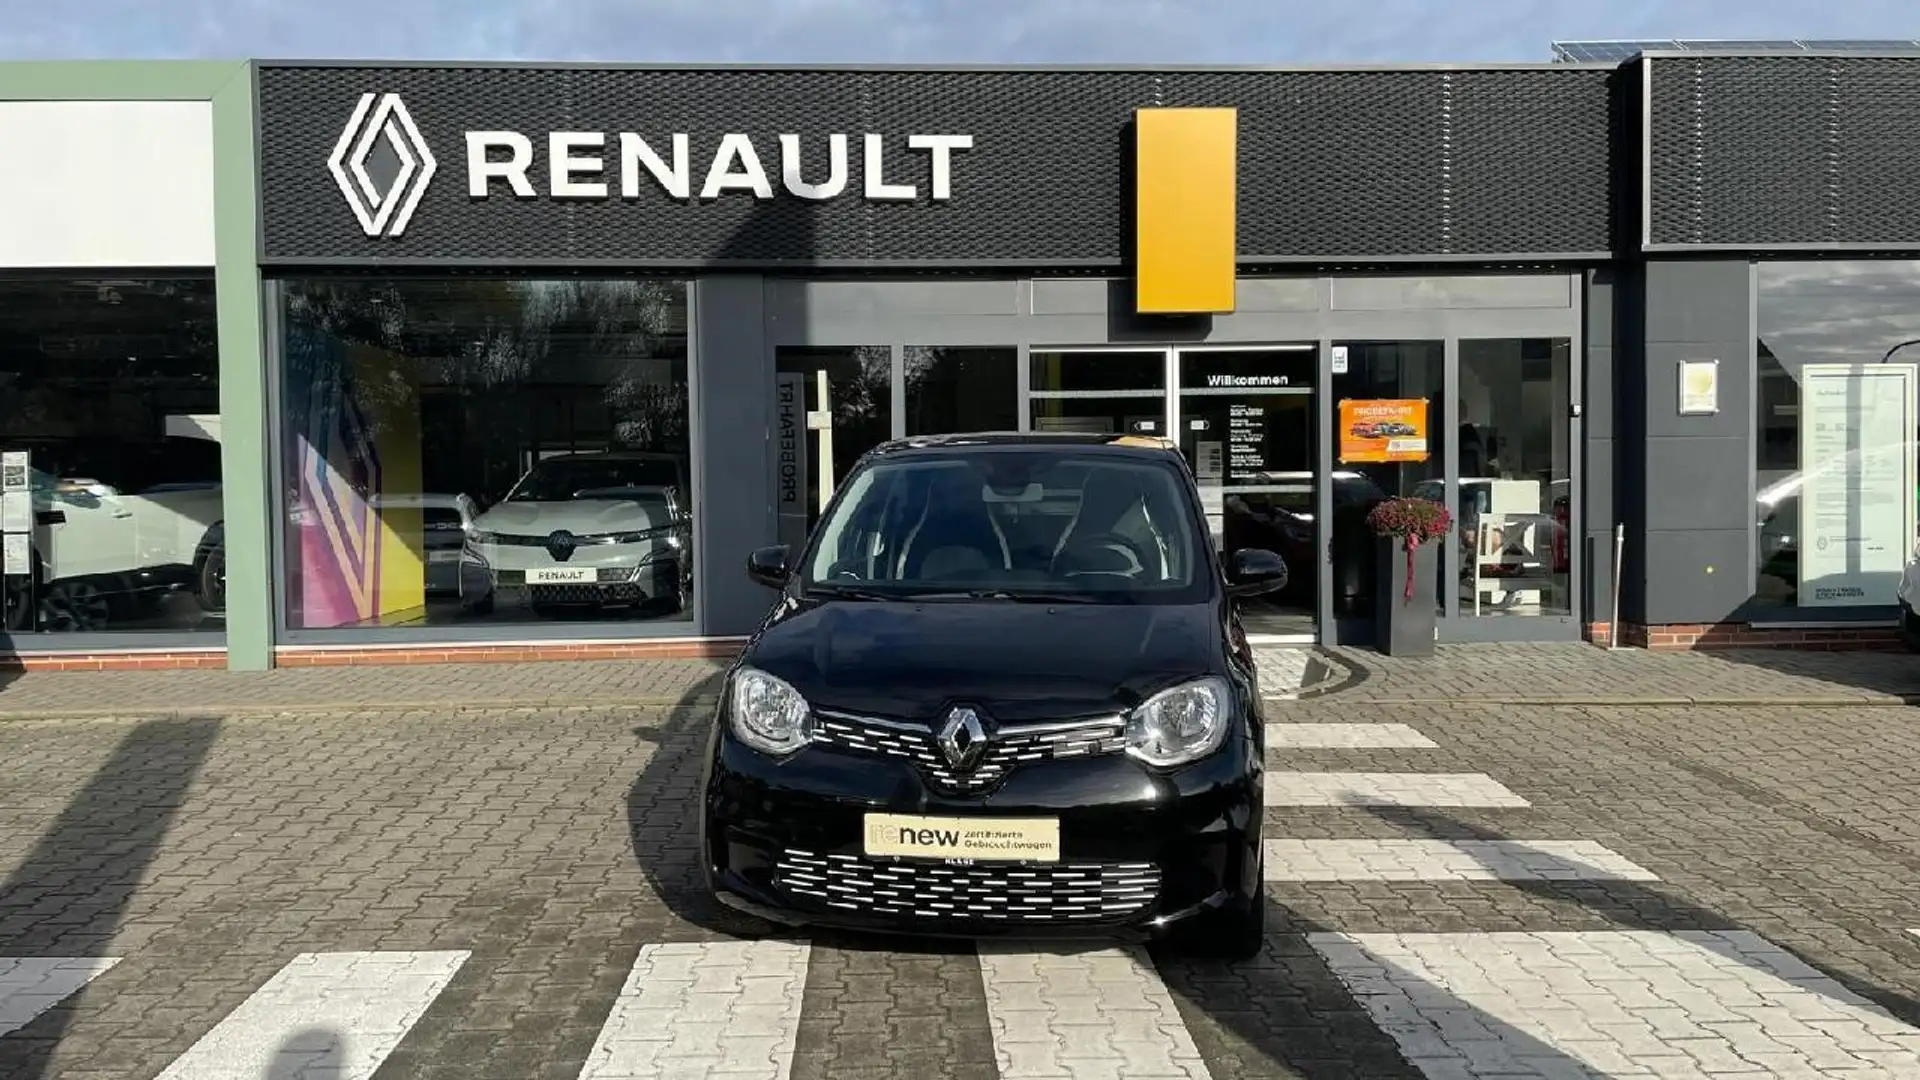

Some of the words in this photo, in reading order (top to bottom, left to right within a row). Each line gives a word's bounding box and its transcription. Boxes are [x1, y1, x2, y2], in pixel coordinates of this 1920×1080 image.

[465, 131, 973, 200] RENAULT
[1207, 375, 1288, 387] Willkommen
[538, 571, 584, 580] RENAULT
[870, 823, 960, 847] renew
